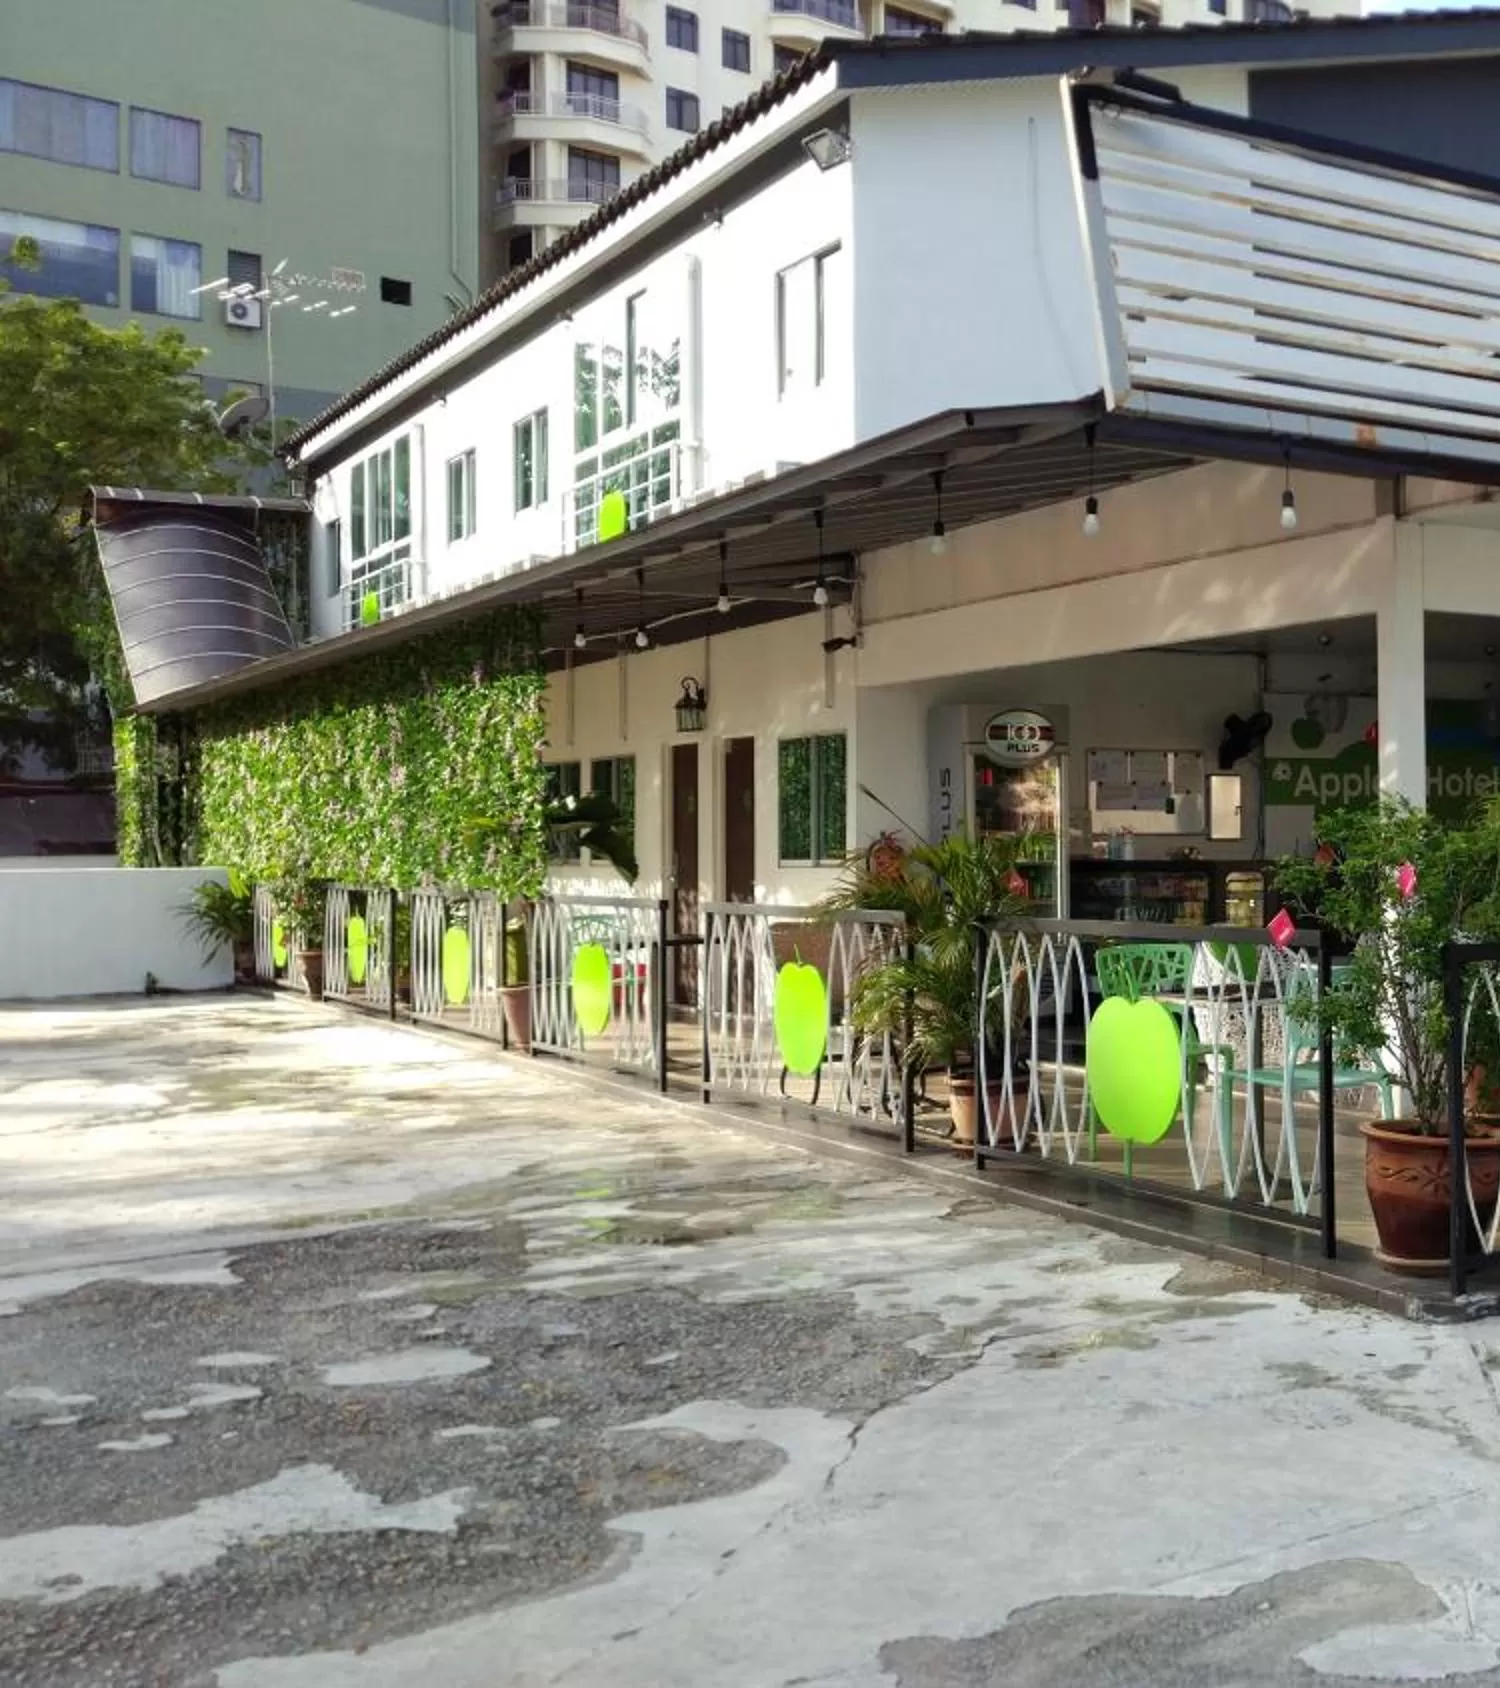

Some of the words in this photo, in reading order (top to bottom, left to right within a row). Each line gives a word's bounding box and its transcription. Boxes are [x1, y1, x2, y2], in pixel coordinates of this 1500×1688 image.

[1006, 723, 1041, 740] 100
[1006, 741, 1040, 753] PLUS
[1426, 765, 1499, 797] Hotel
